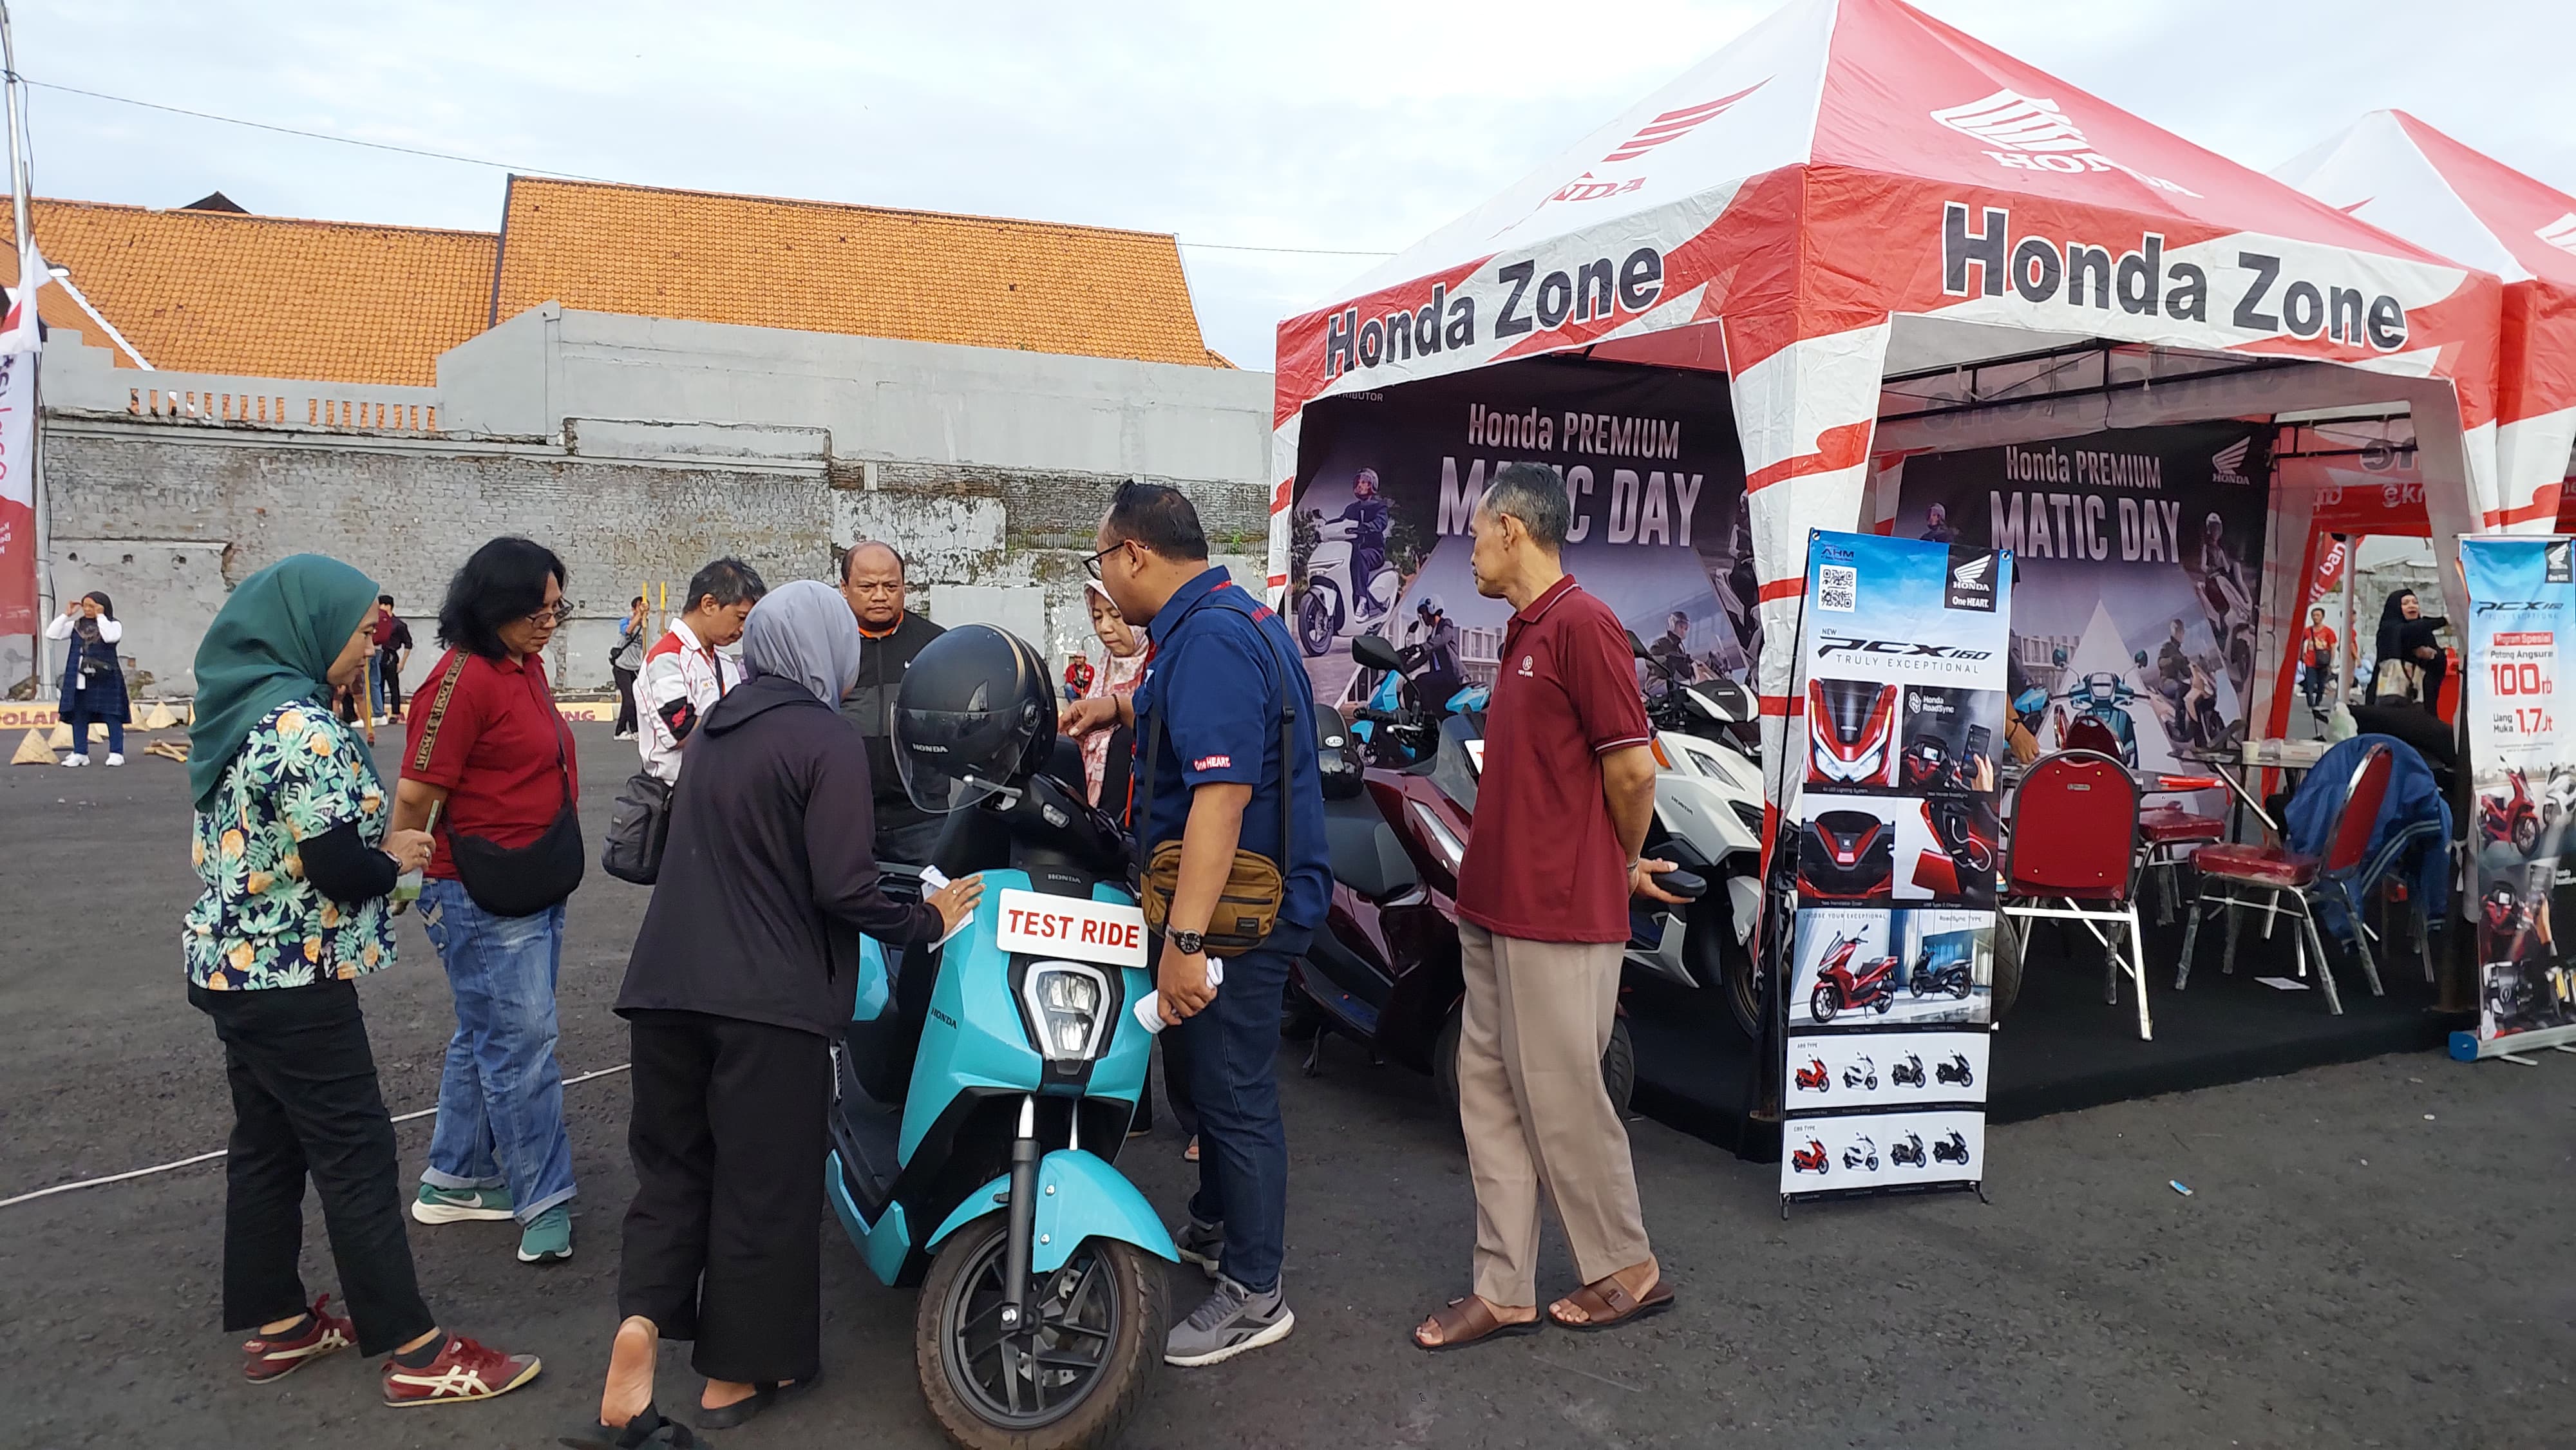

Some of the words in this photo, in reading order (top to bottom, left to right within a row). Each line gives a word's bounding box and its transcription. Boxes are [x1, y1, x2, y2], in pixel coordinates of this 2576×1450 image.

[1942, 203, 2208, 323] Honda
[2233, 251, 2406, 353] Zone
[1325, 285, 1475, 379] Honda
[1495, 247, 1663, 341] Zone
[1468, 404, 1553, 453] Honda
[1564, 412, 1680, 459] PREMIUM
[2006, 445, 2070, 486] Honda
[2075, 449, 2161, 489] PREMIUM
[2213, 473, 2249, 485] HONDA
[1607, 471, 1703, 547] DAY
[1990, 491, 2108, 561] MATIC
[2119, 498, 2181, 563] DAY
[1821, 549, 1855, 558] AHM
[1953, 581, 1990, 591] HONDA
[1952, 596, 1966, 605] One
[2521, 633, 2551, 645] Spesial
[1837, 654, 1879, 666] TRULY
[1888, 658, 1979, 674] EXCEPTIONAL
[2491, 663, 2541, 696] 100
[2542, 675, 2552, 694] rb
[1922, 704, 1955, 713] RoadSync
[1923, 695, 1944, 704] Honda
[2494, 713, 2512, 723] Uang
[2494, 725, 2514, 733] Muka
[2516, 707, 2543, 737] 1,7
[912, 742, 949, 753] HONDA
[1047, 873, 1081, 883] HONDA
[1009, 909, 1074, 939] TEST
[1081, 919, 1139, 949] RIDE
[931, 1007, 957, 1030] HONDA
